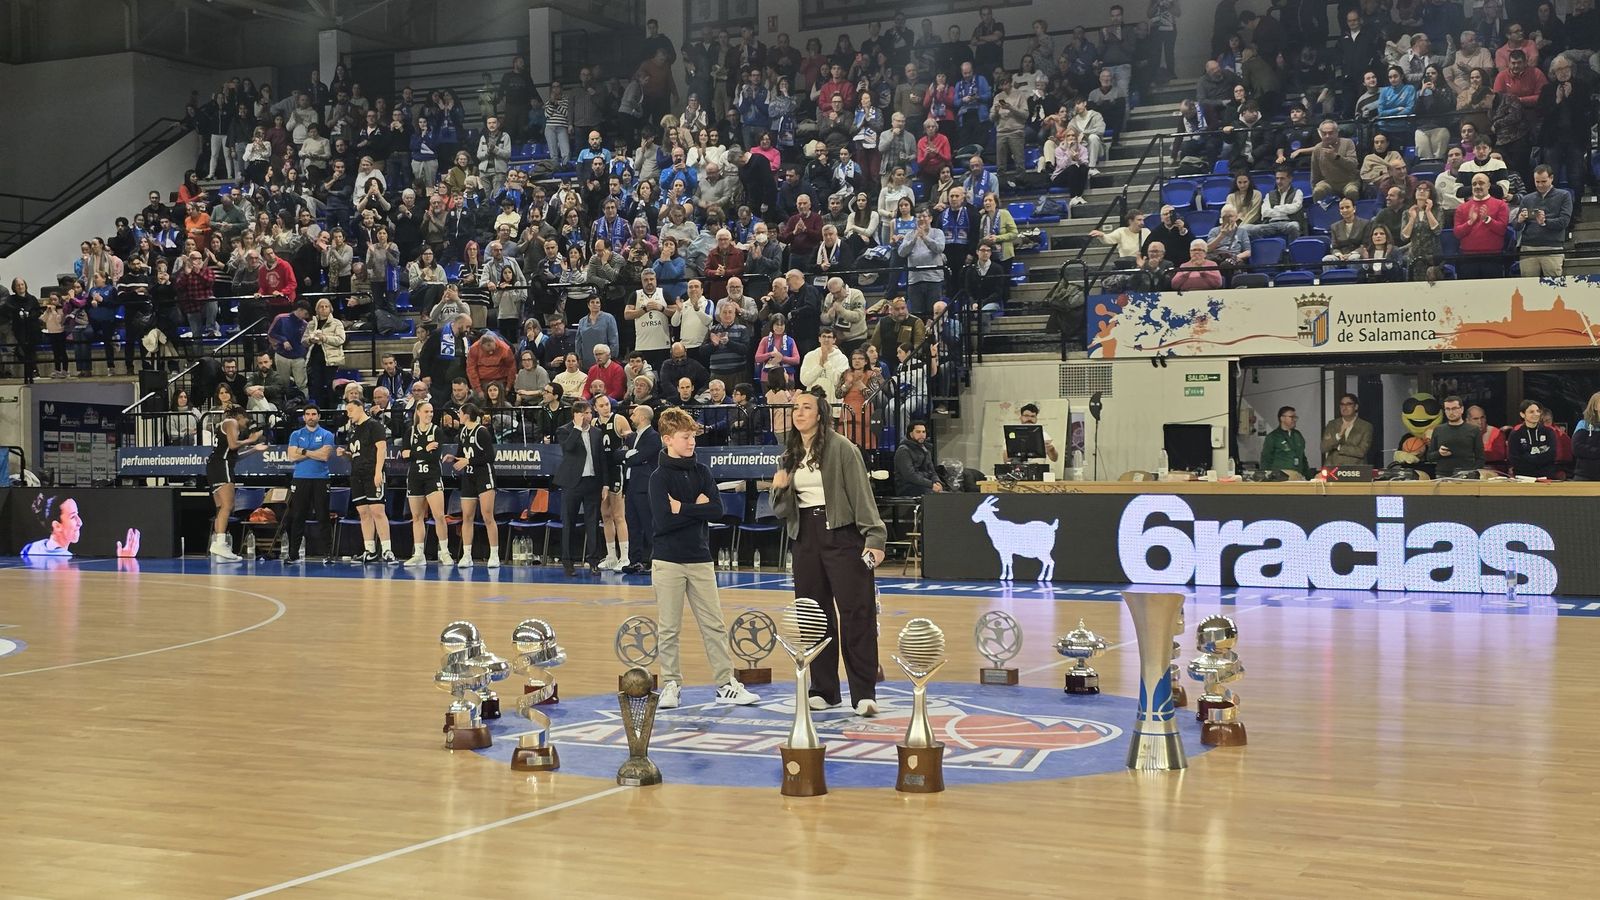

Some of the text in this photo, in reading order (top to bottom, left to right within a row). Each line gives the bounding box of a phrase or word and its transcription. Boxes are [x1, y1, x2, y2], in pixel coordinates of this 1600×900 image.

[648, 311, 654, 320] 6
[1337, 308, 1436, 328] Ayuntamiento
[1337, 327, 1436, 343] de Salamanca
[418, 464, 429, 473] 16
